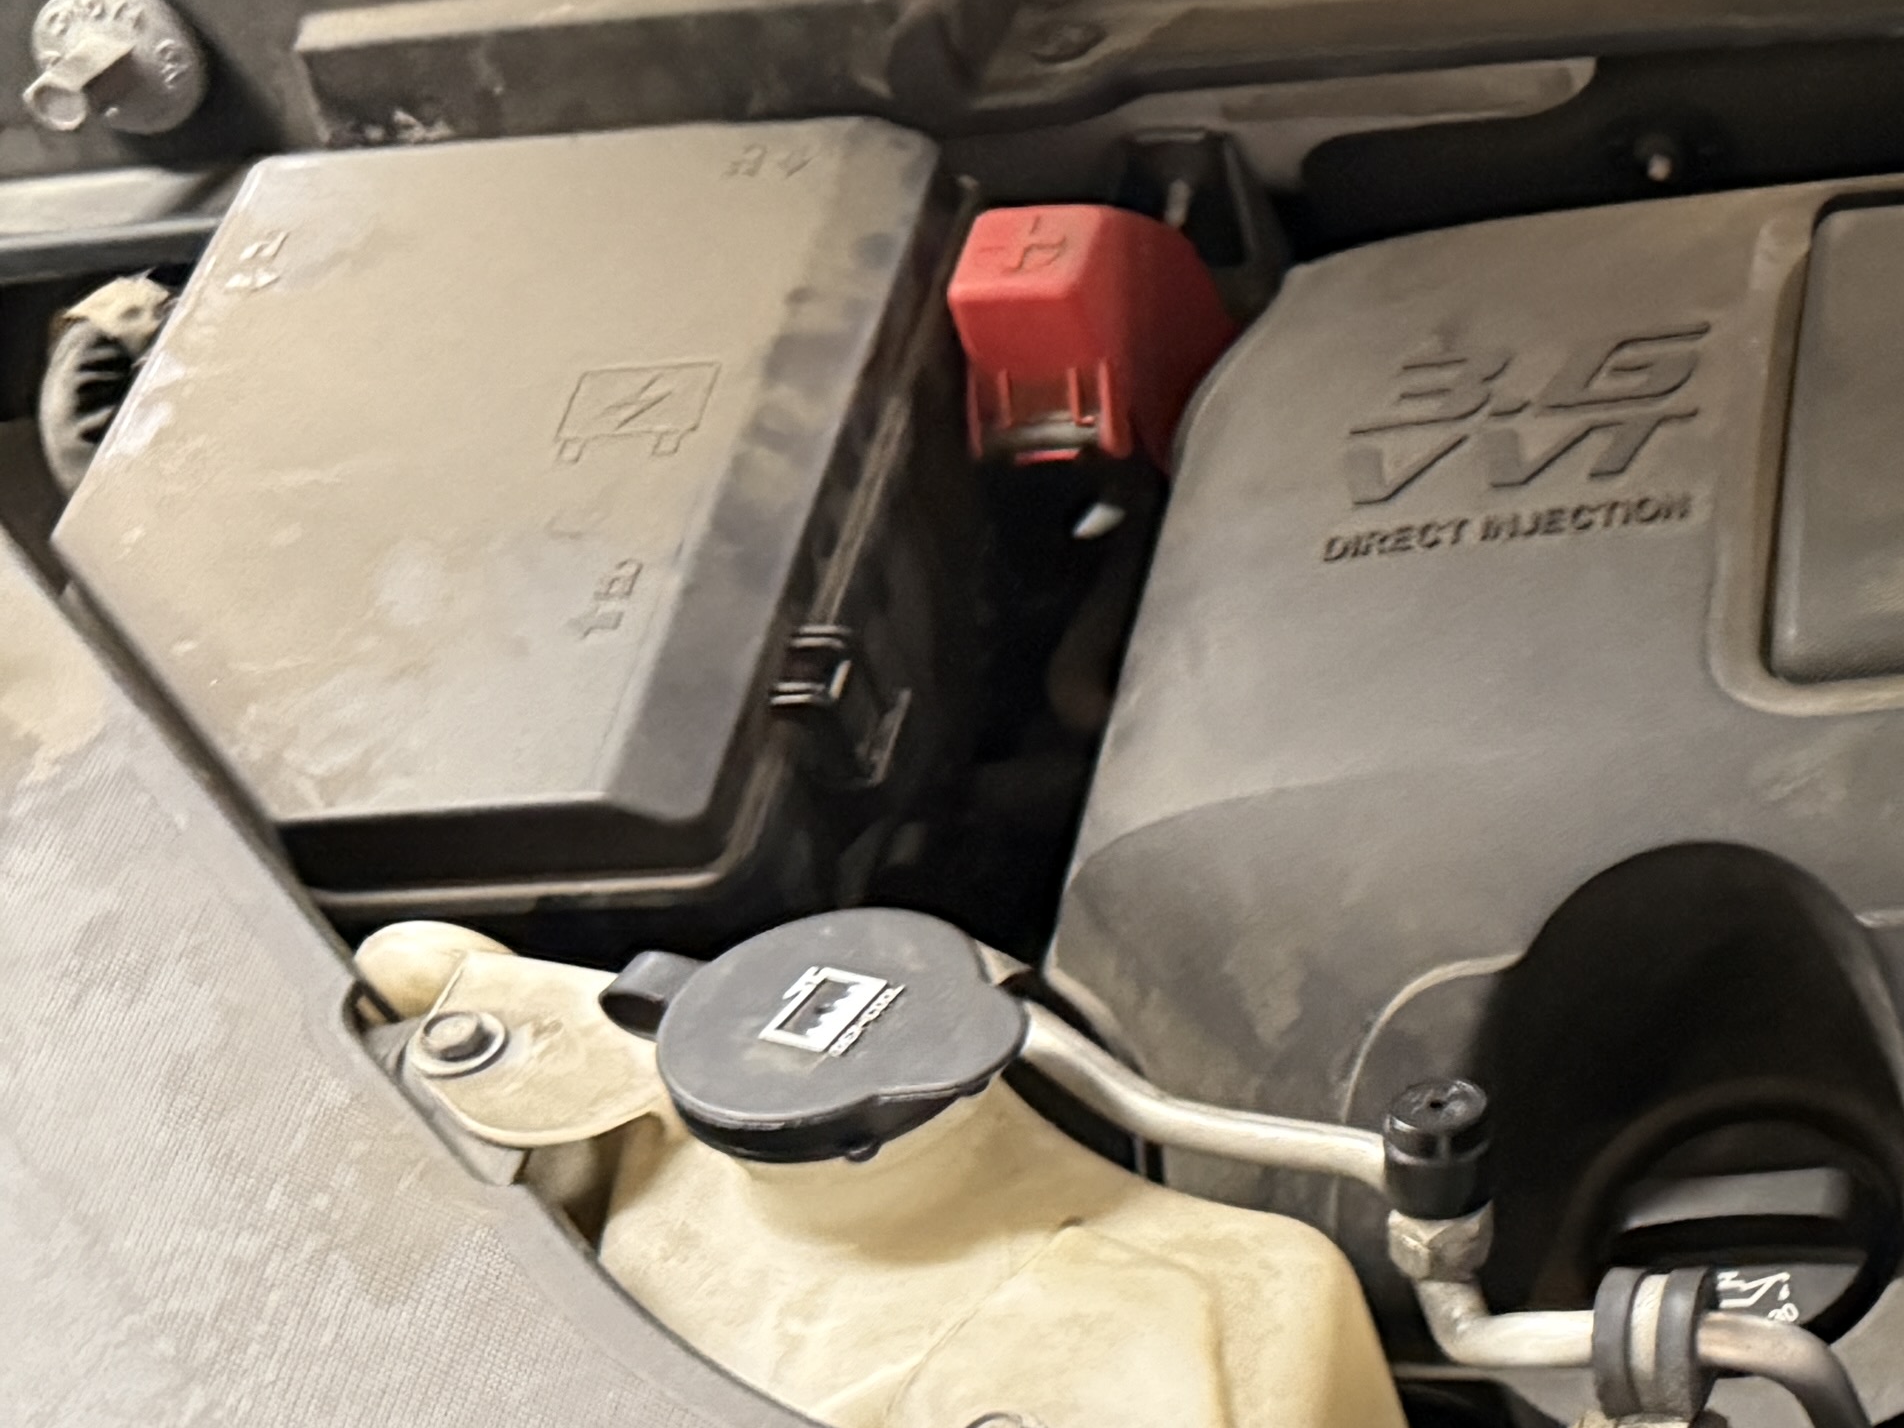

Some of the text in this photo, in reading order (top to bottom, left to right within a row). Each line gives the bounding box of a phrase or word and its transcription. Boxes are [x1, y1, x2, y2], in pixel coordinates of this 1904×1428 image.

[1350, 321, 1712, 437] 3.6
[1344, 408, 1700, 506] VVT
[1322, 492, 1693, 563] DIRECT INJECTION
